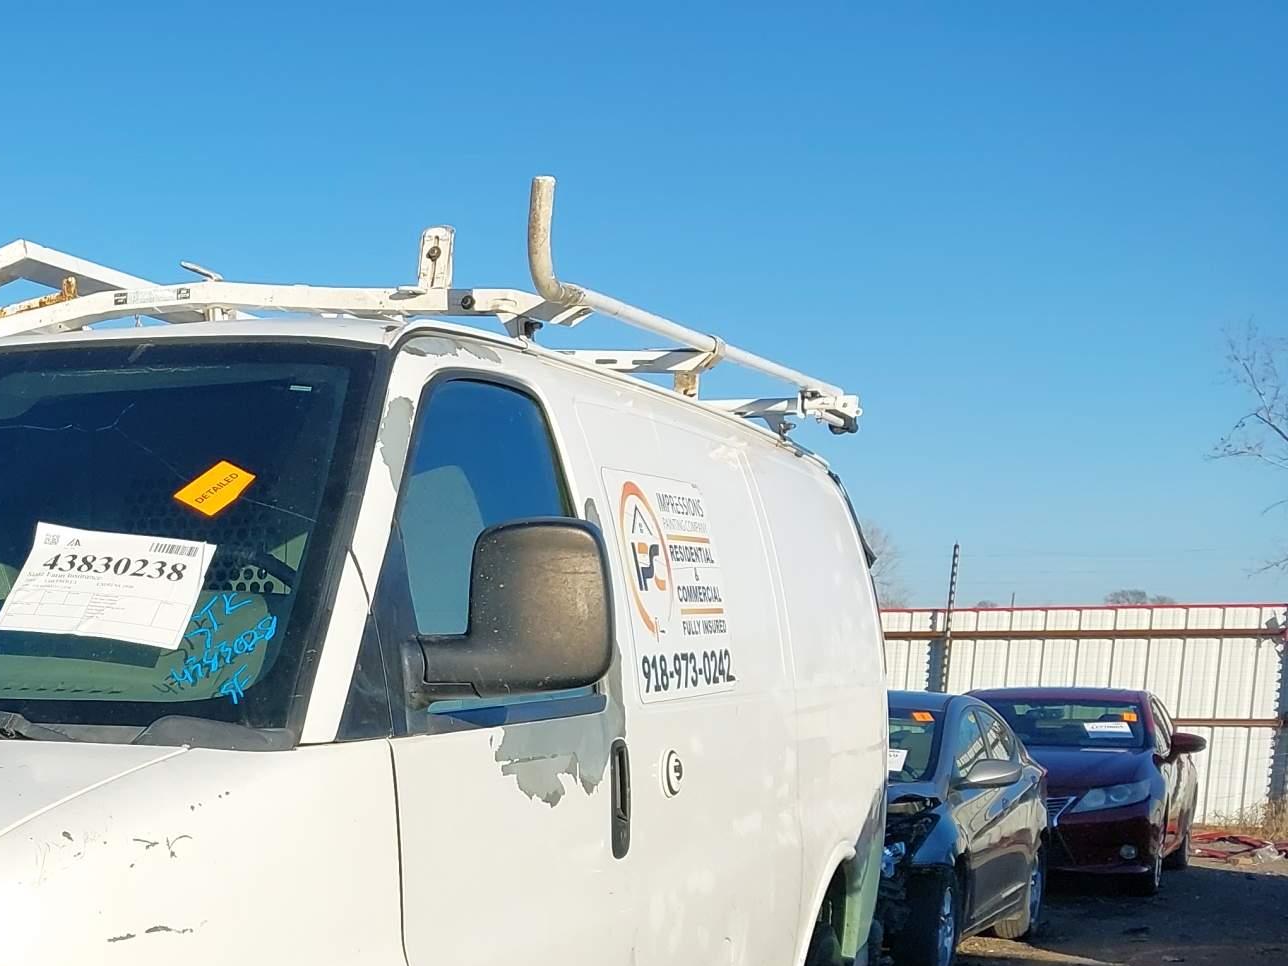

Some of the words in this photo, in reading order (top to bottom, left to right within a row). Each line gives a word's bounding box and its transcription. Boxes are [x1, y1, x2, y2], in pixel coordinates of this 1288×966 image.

[194, 472, 239, 504] DETAILED
[656, 492, 704, 518] IMPRESSIONS
[669, 544, 715, 564] RESIDENTIAL
[42, 553, 188, 582] 43830238
[677, 585, 722, 603] COMMERCIAL
[682, 620, 701, 635] FULLY
[702, 619, 727, 635] INSURED
[642, 648, 737, 693] 918-973-0242
